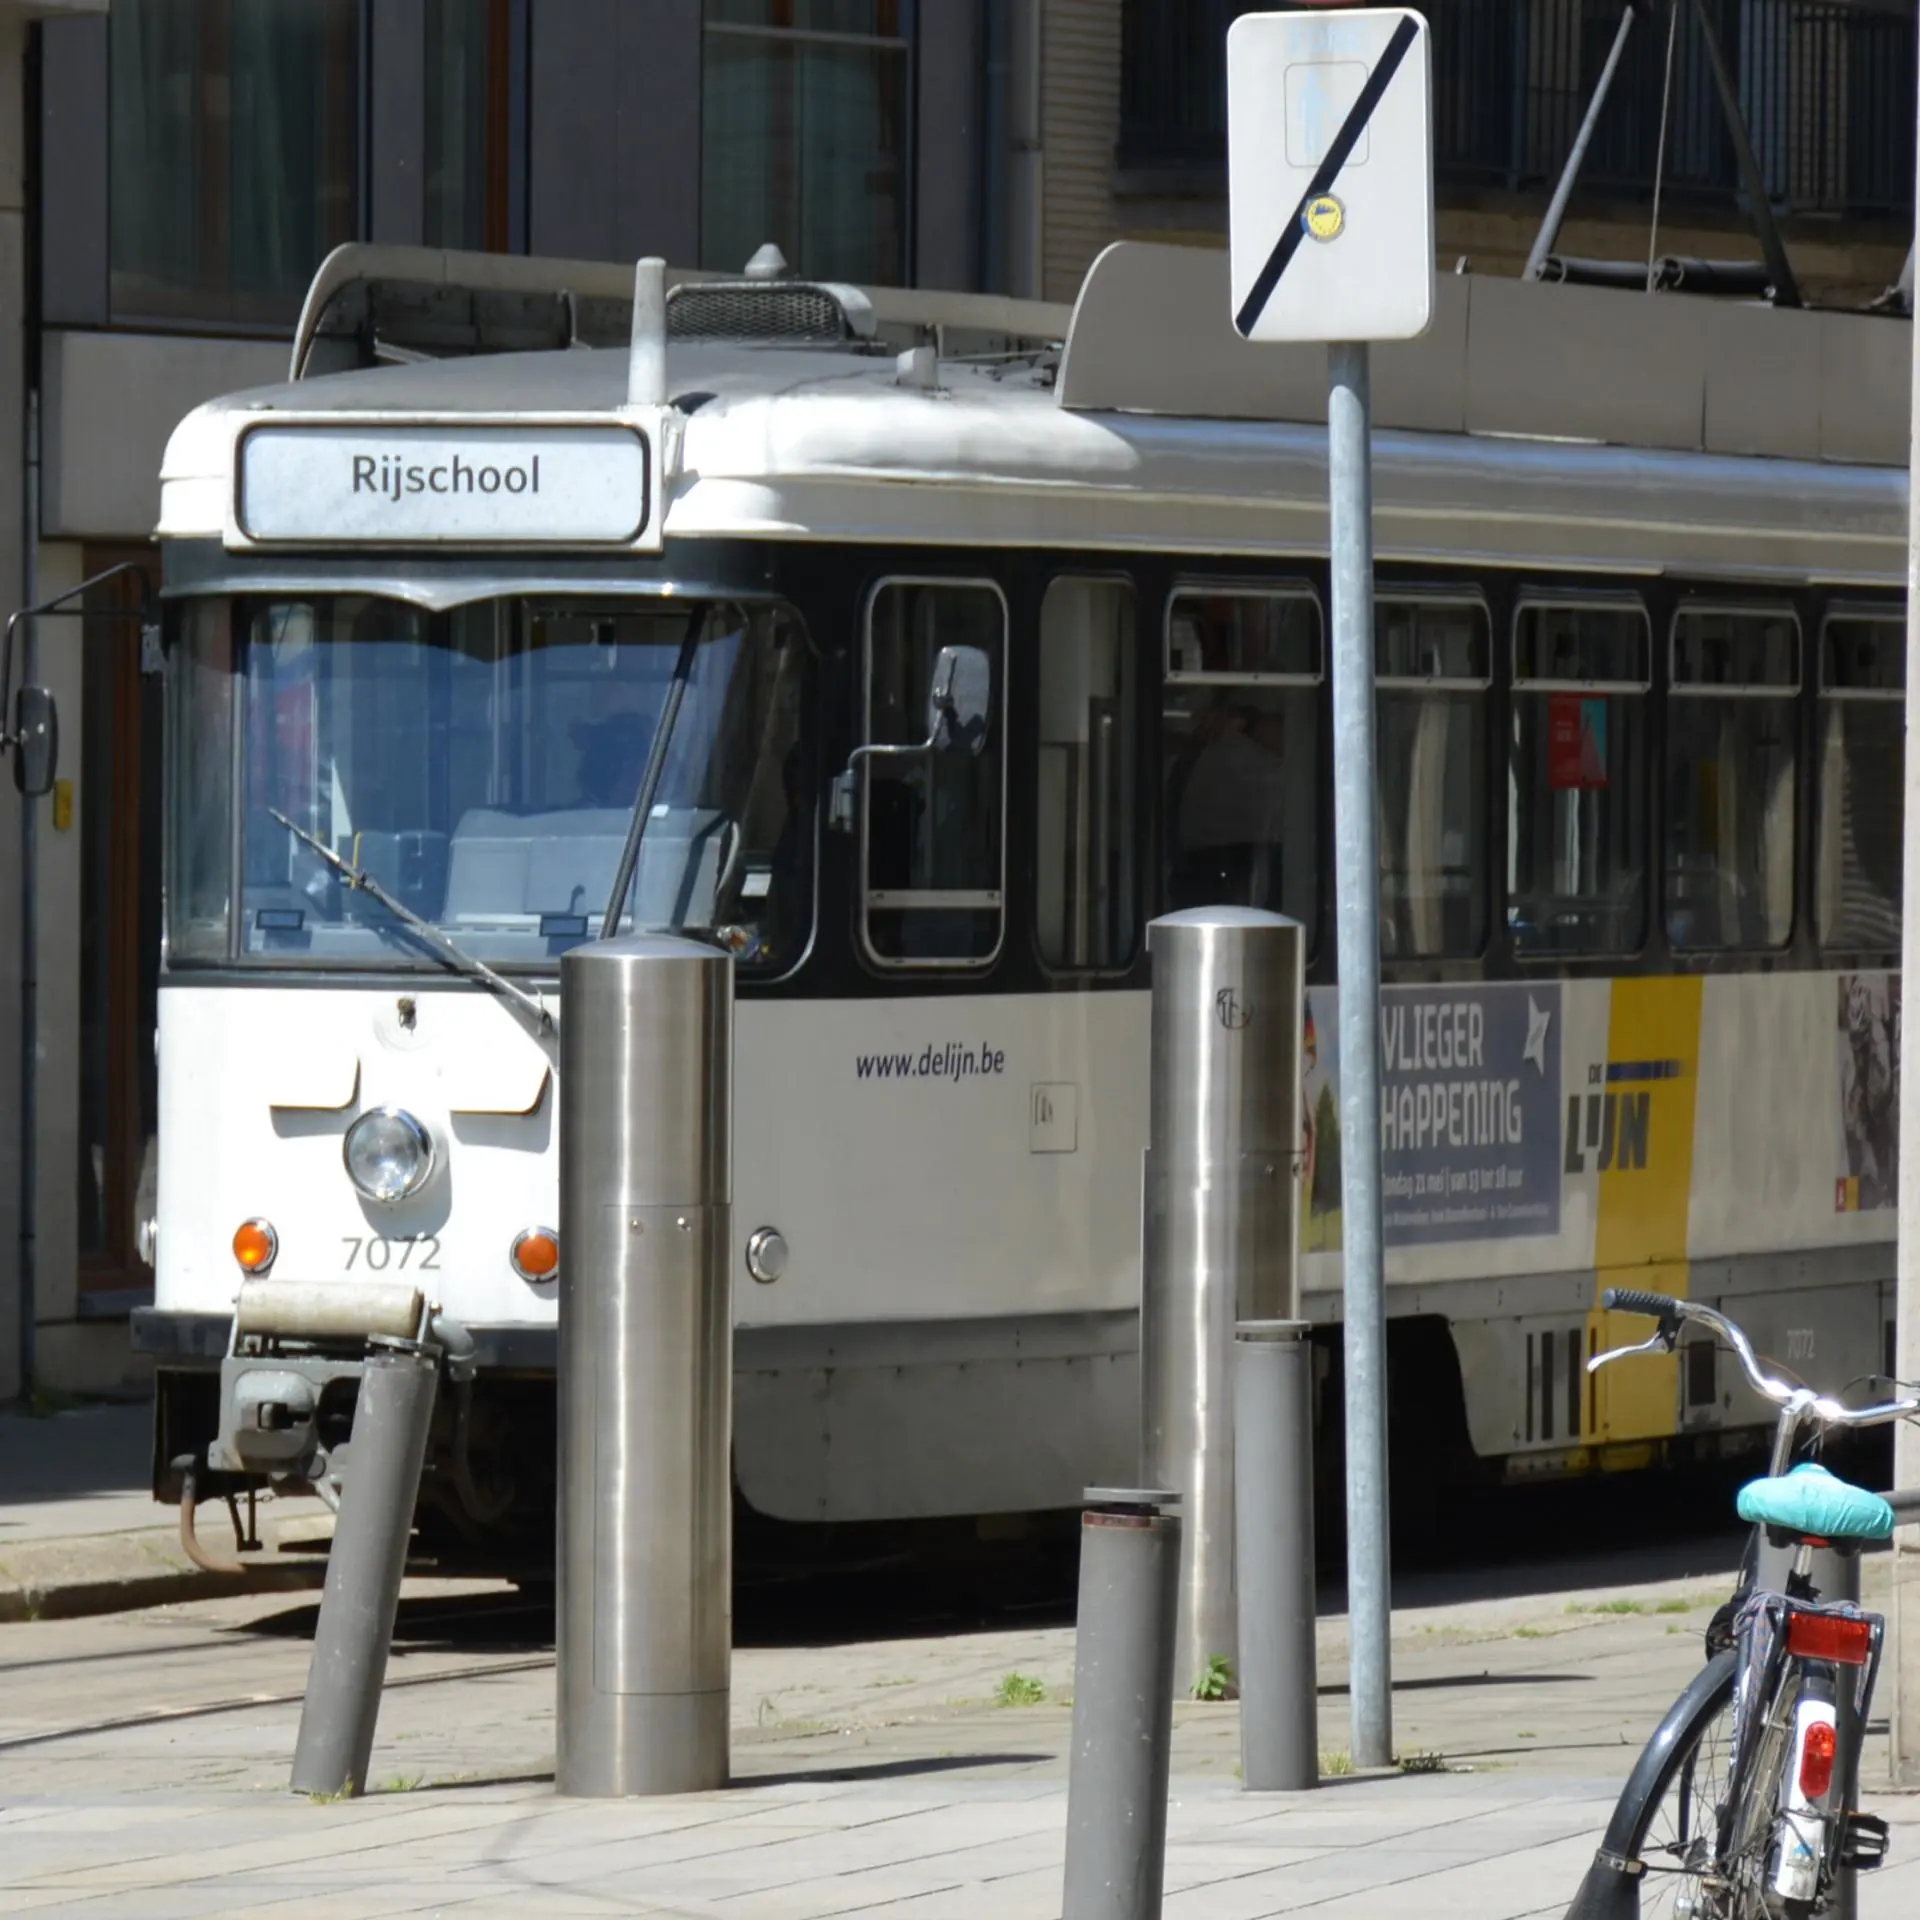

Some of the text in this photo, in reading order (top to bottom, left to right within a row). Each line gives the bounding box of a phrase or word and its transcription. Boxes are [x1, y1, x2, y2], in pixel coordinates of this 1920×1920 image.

[353, 454, 540, 502] Rijschool
[1382, 1003, 1484, 1071] VLIEGER
[856, 1041, 1005, 1083] www.delijn.be
[1381, 1080, 1522, 1151] HAPPENING
[342, 1236, 441, 1271] 7072
[1787, 1328, 1816, 1360] 7072
